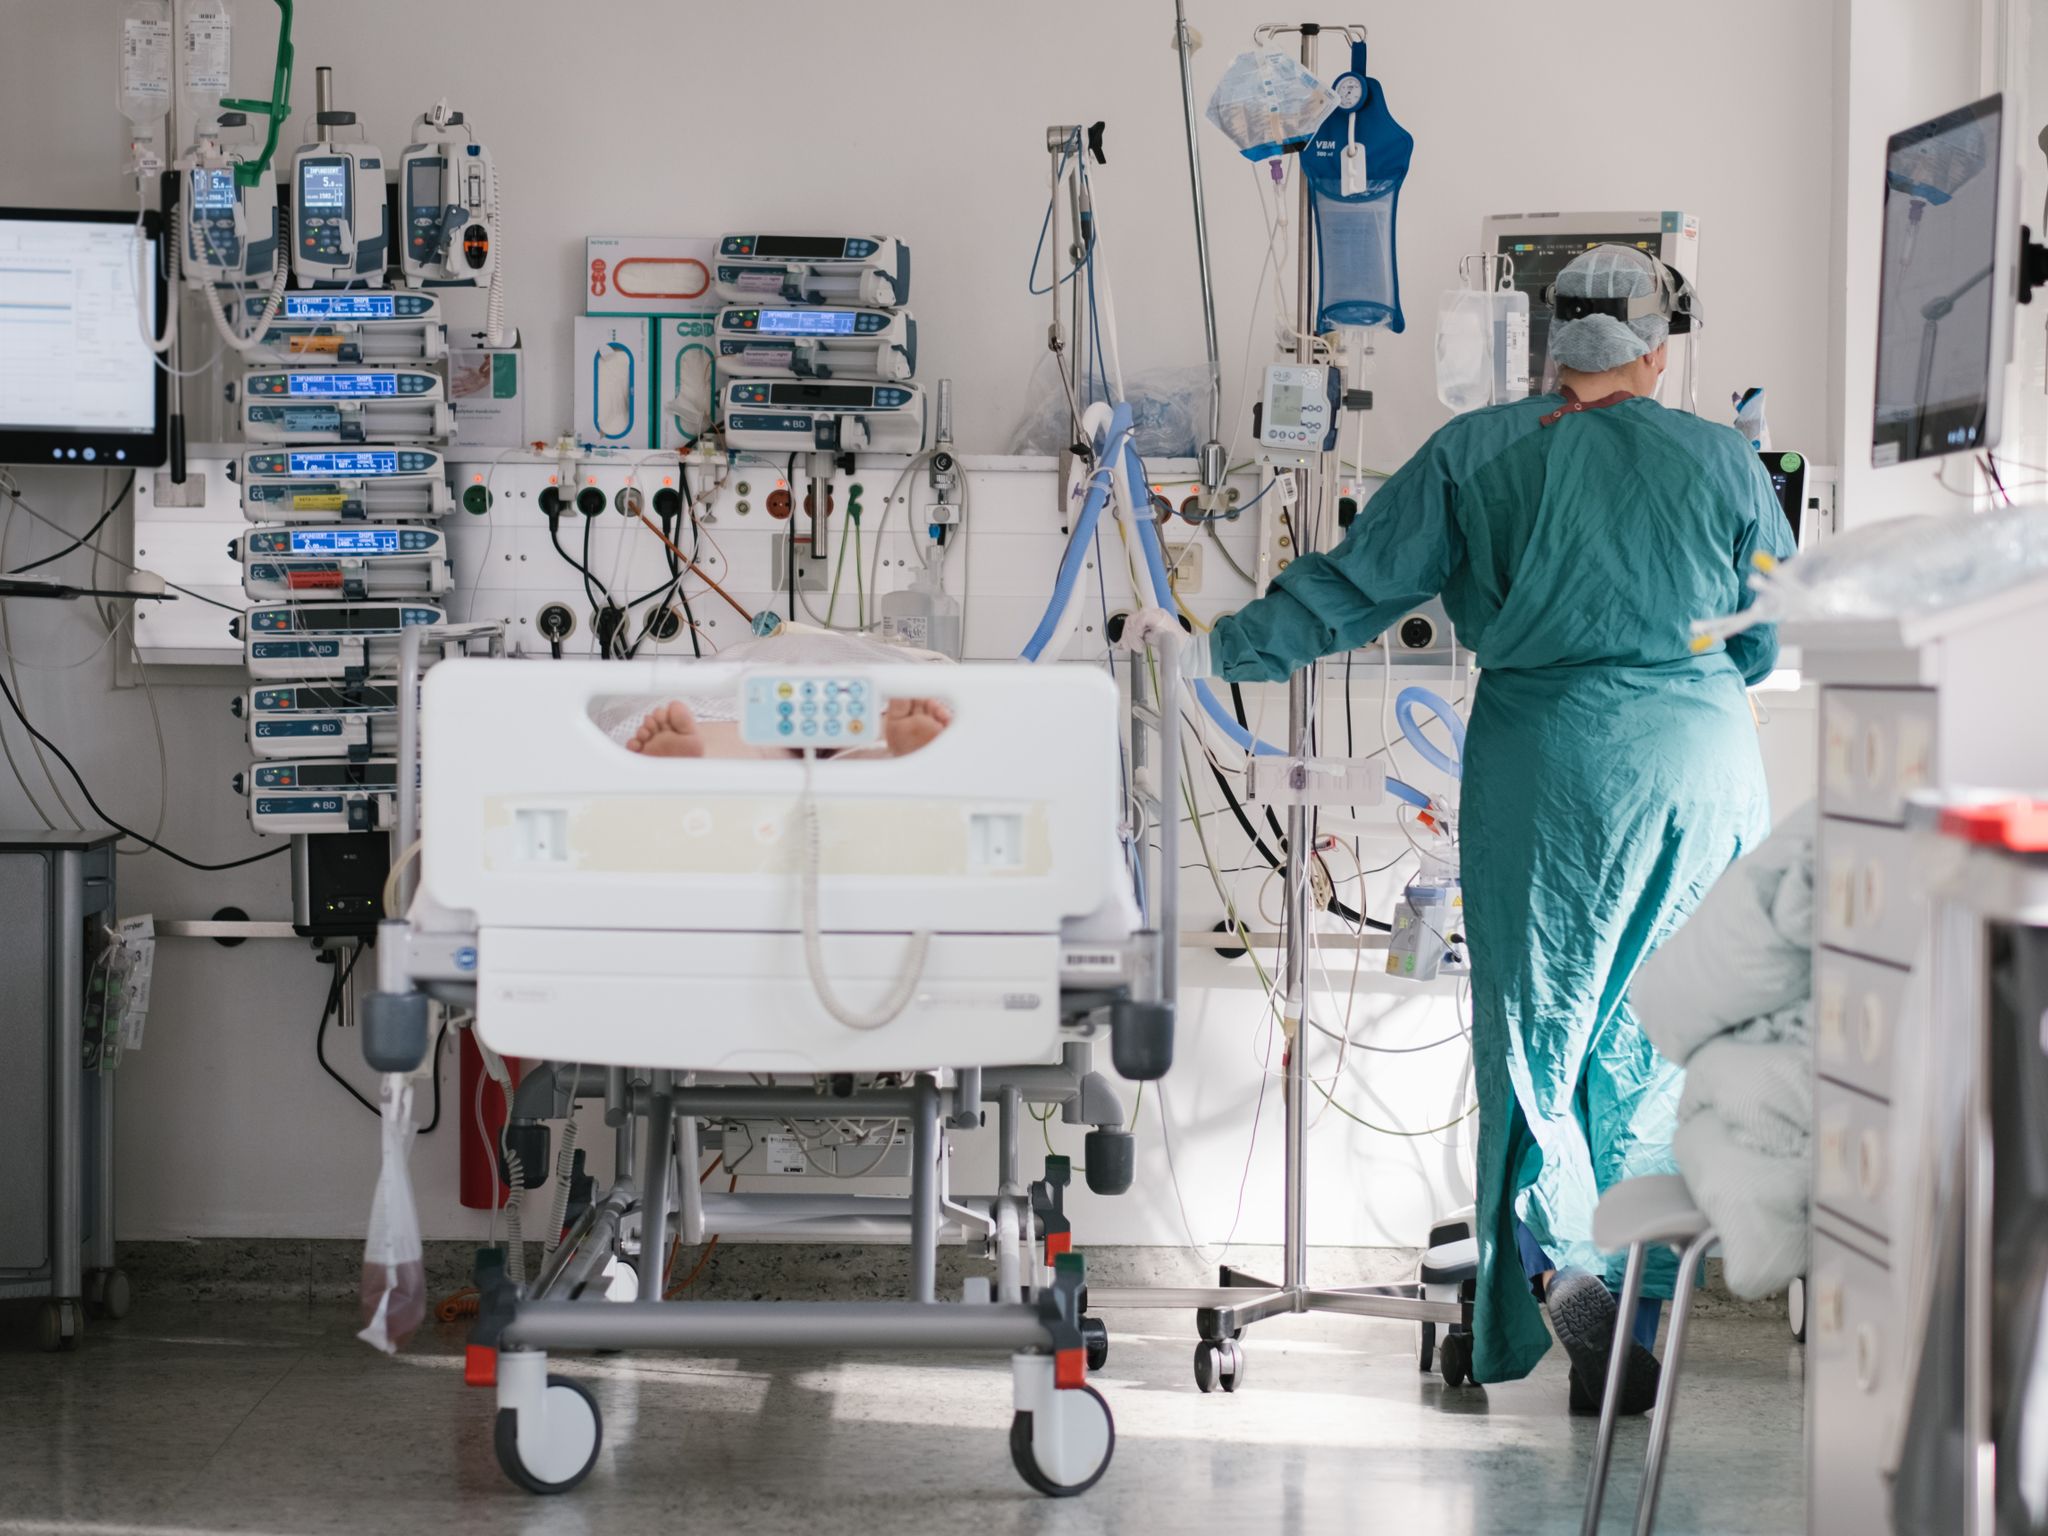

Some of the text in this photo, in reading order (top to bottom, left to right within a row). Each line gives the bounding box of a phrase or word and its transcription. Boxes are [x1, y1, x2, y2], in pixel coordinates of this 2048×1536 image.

[1316, 141, 1335, 149] VBM
[252, 412, 263, 420] CC
[732, 420, 806, 428] CC BD
[254, 569, 265, 578] CC
[255, 645, 332, 656] CC BD
[259, 724, 335, 735] CC BD
[260, 801, 336, 812] CC BD
